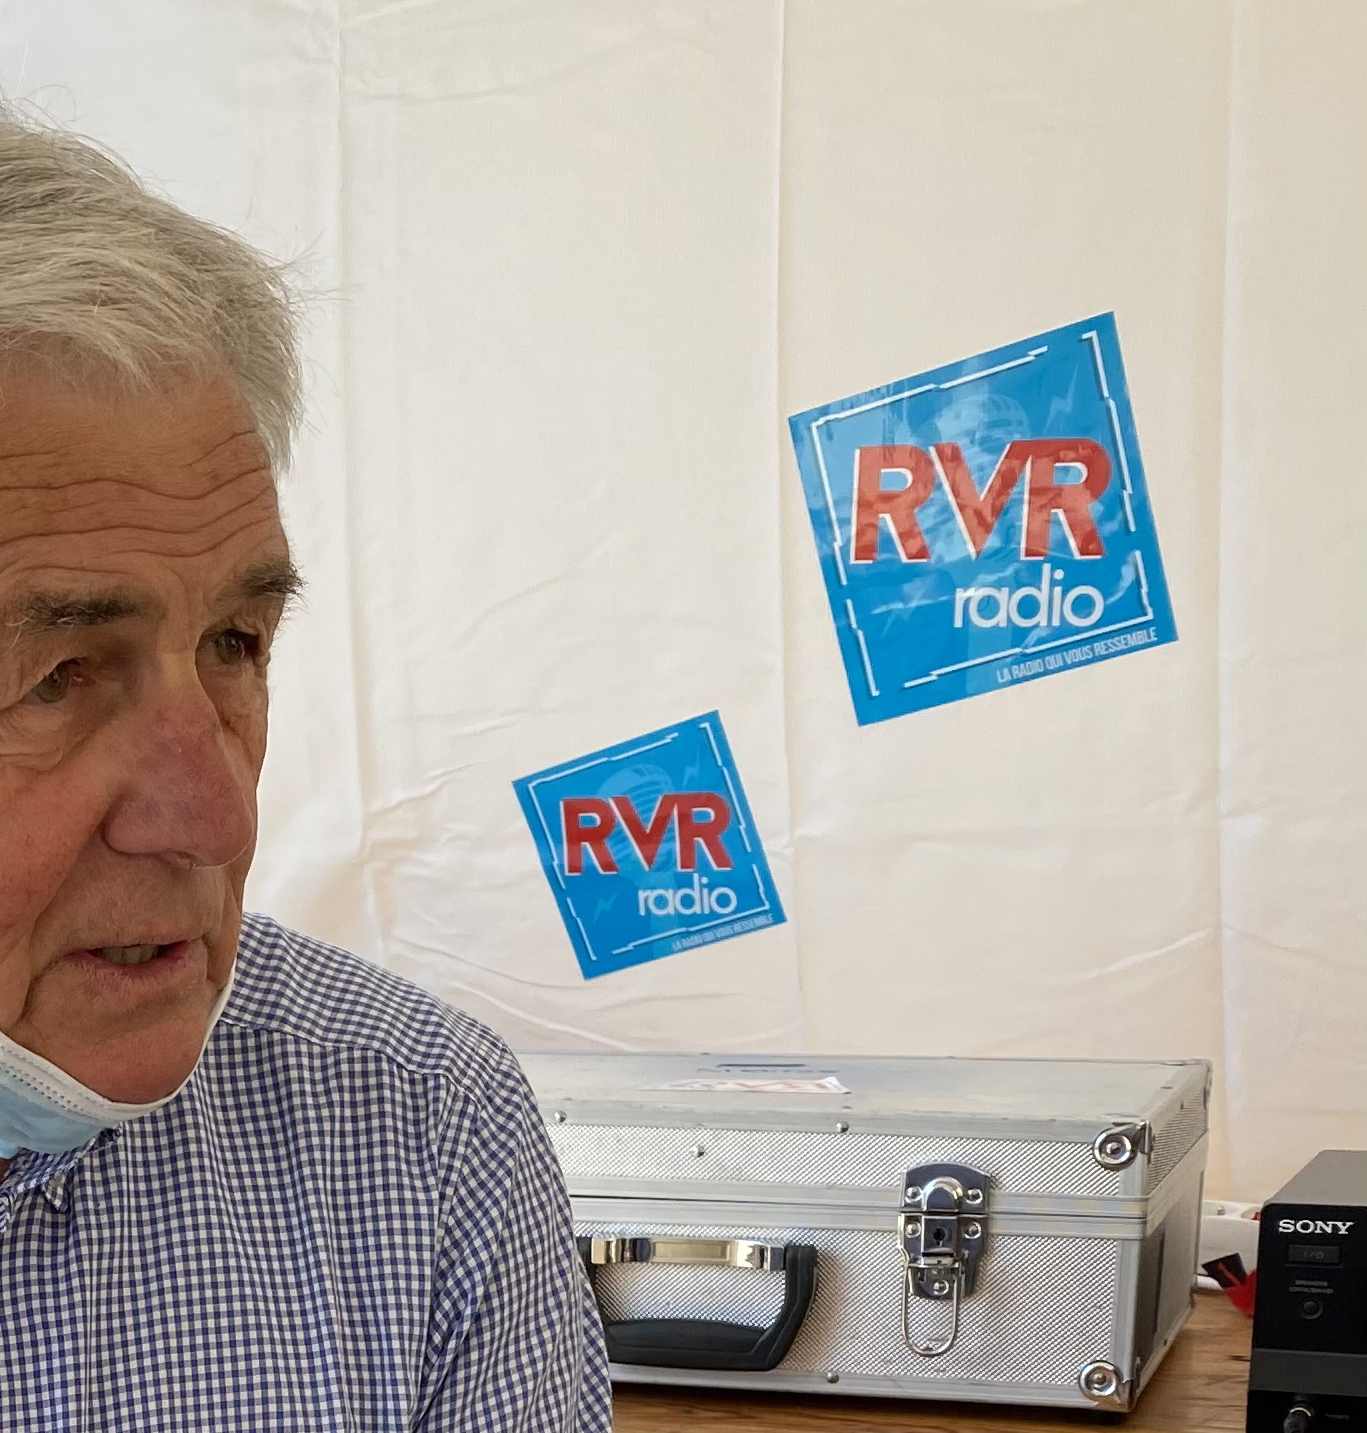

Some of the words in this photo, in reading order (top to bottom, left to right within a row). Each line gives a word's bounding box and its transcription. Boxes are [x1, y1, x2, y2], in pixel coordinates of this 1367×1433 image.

[850, 438, 1112, 565] RVR
[953, 563, 1105, 628] radio
[996, 668, 1012, 684] LA
[1012, 657, 1045, 680] RADIO
[1045, 652, 1064, 671] QUI
[1063, 645, 1094, 666] VOUS
[1094, 626, 1159, 657] RESSEMBLE
[559, 792, 734, 877] RVR
[637, 873, 738, 916] radio
[1278, 1219, 1355, 1234] SONY
